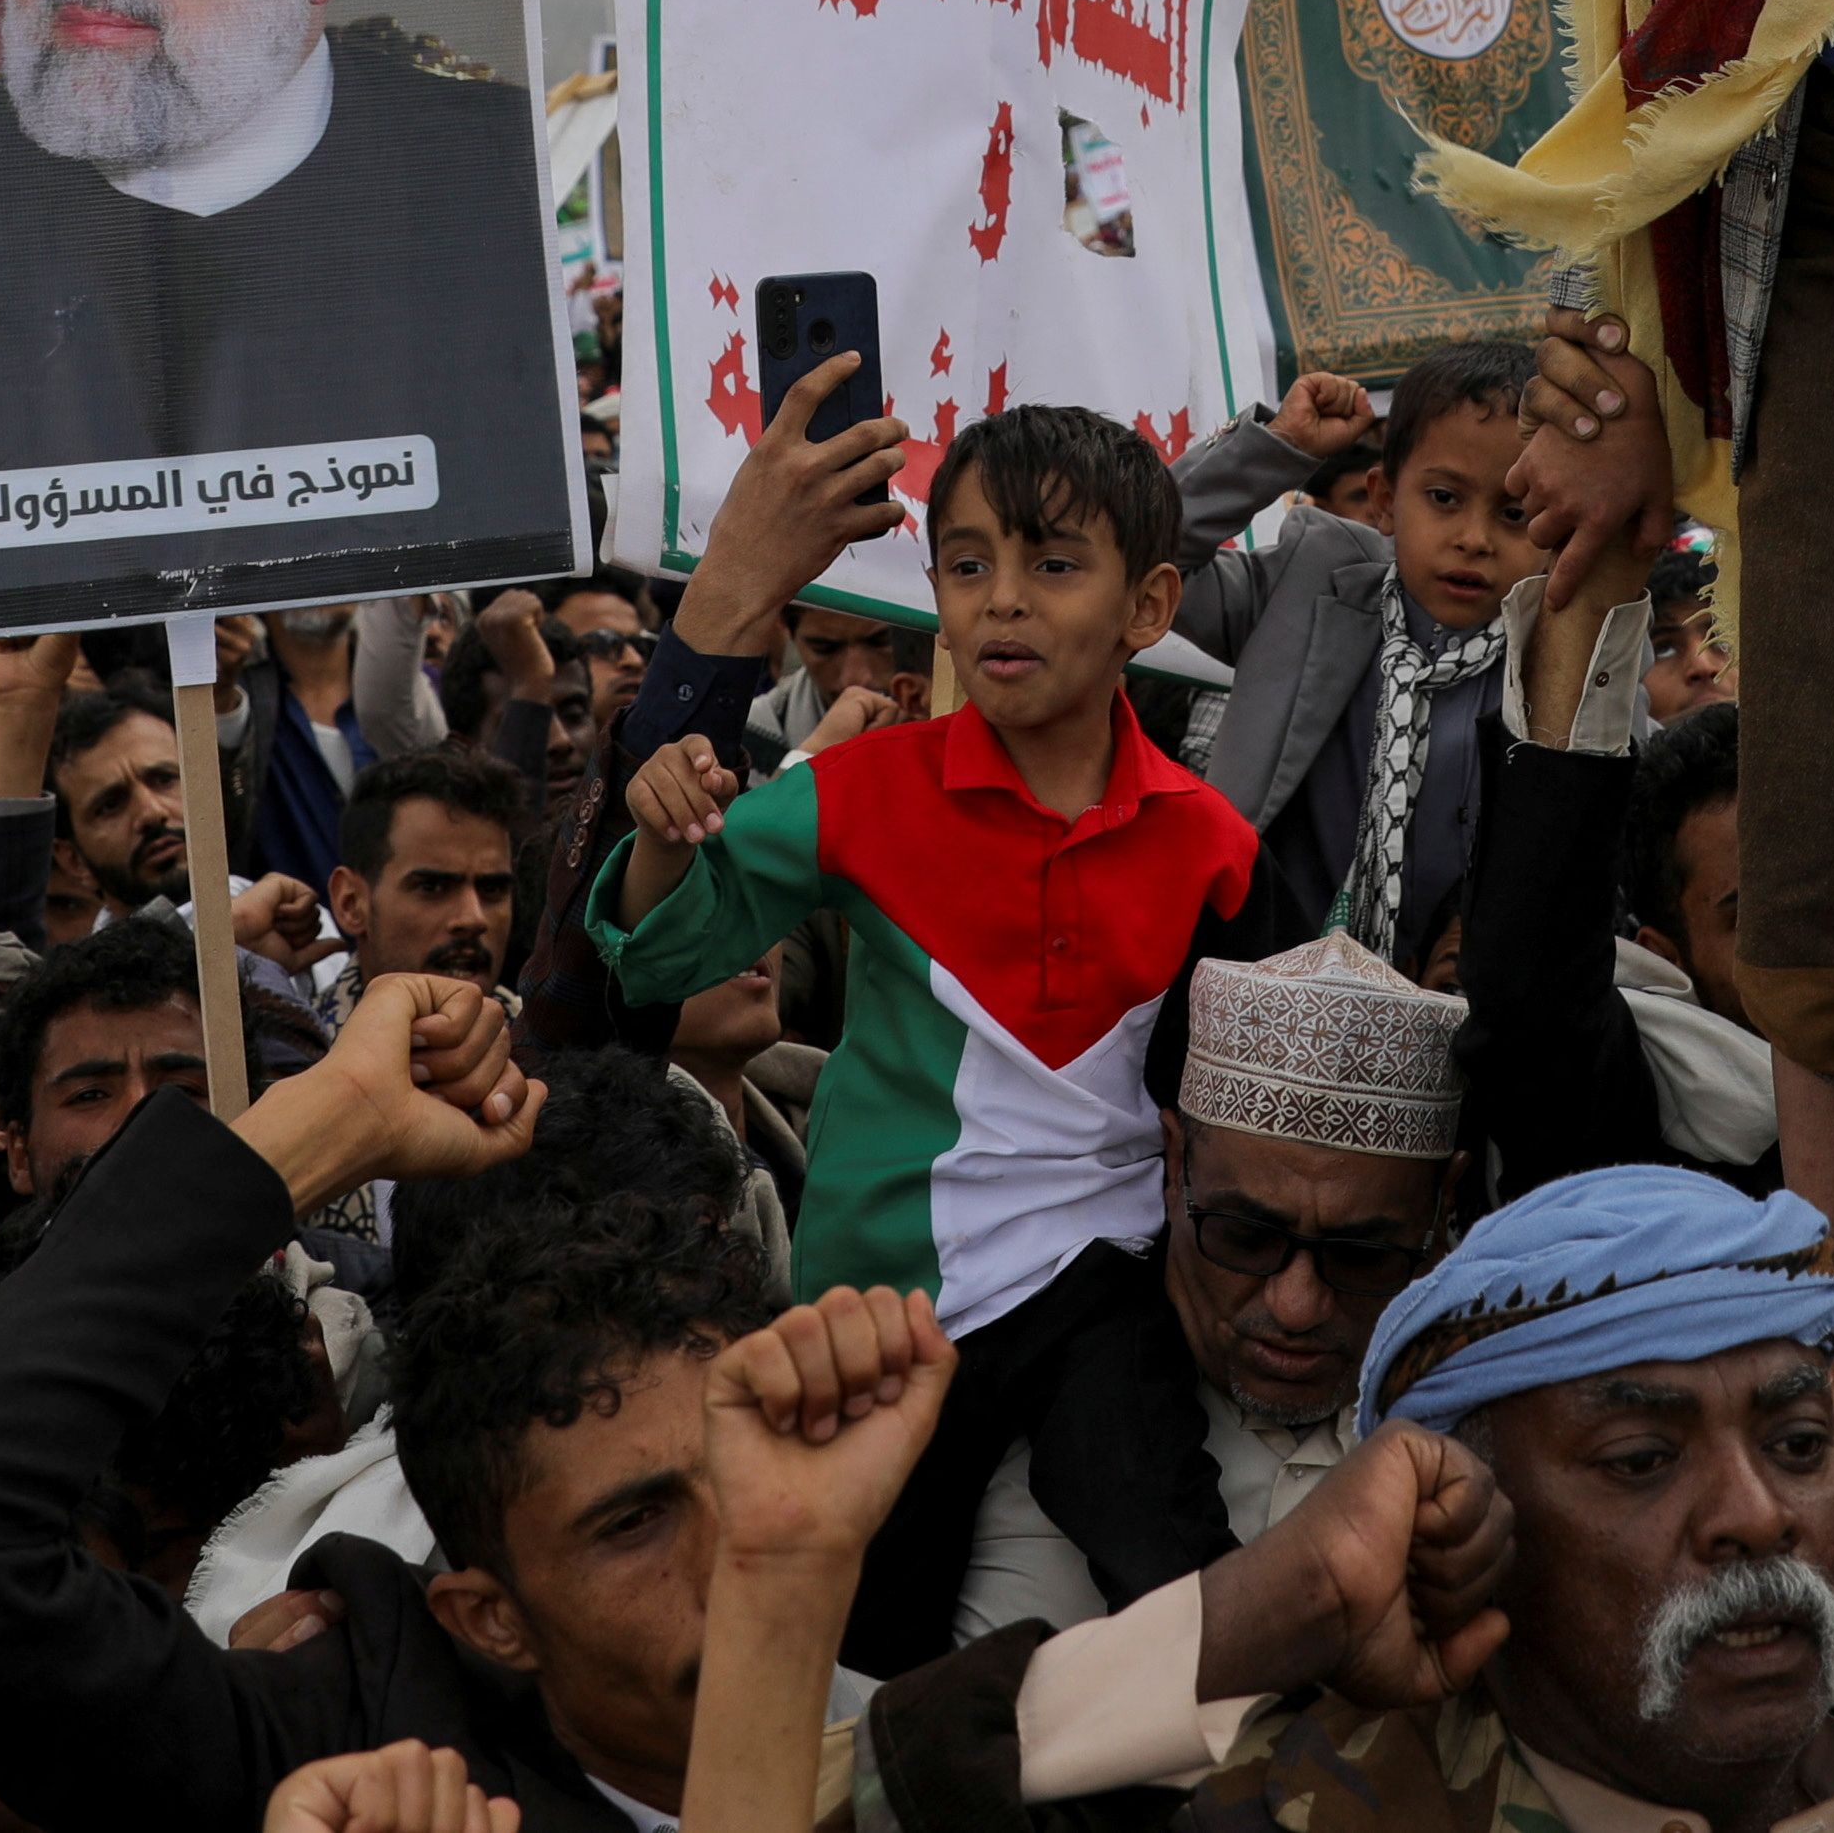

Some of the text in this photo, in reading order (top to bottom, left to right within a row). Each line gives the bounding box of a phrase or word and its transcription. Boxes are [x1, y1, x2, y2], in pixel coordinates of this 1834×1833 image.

[969, 100, 1015, 262] و
[197, 468, 275, 515] في
[288, 450, 415, 509] نموذج
